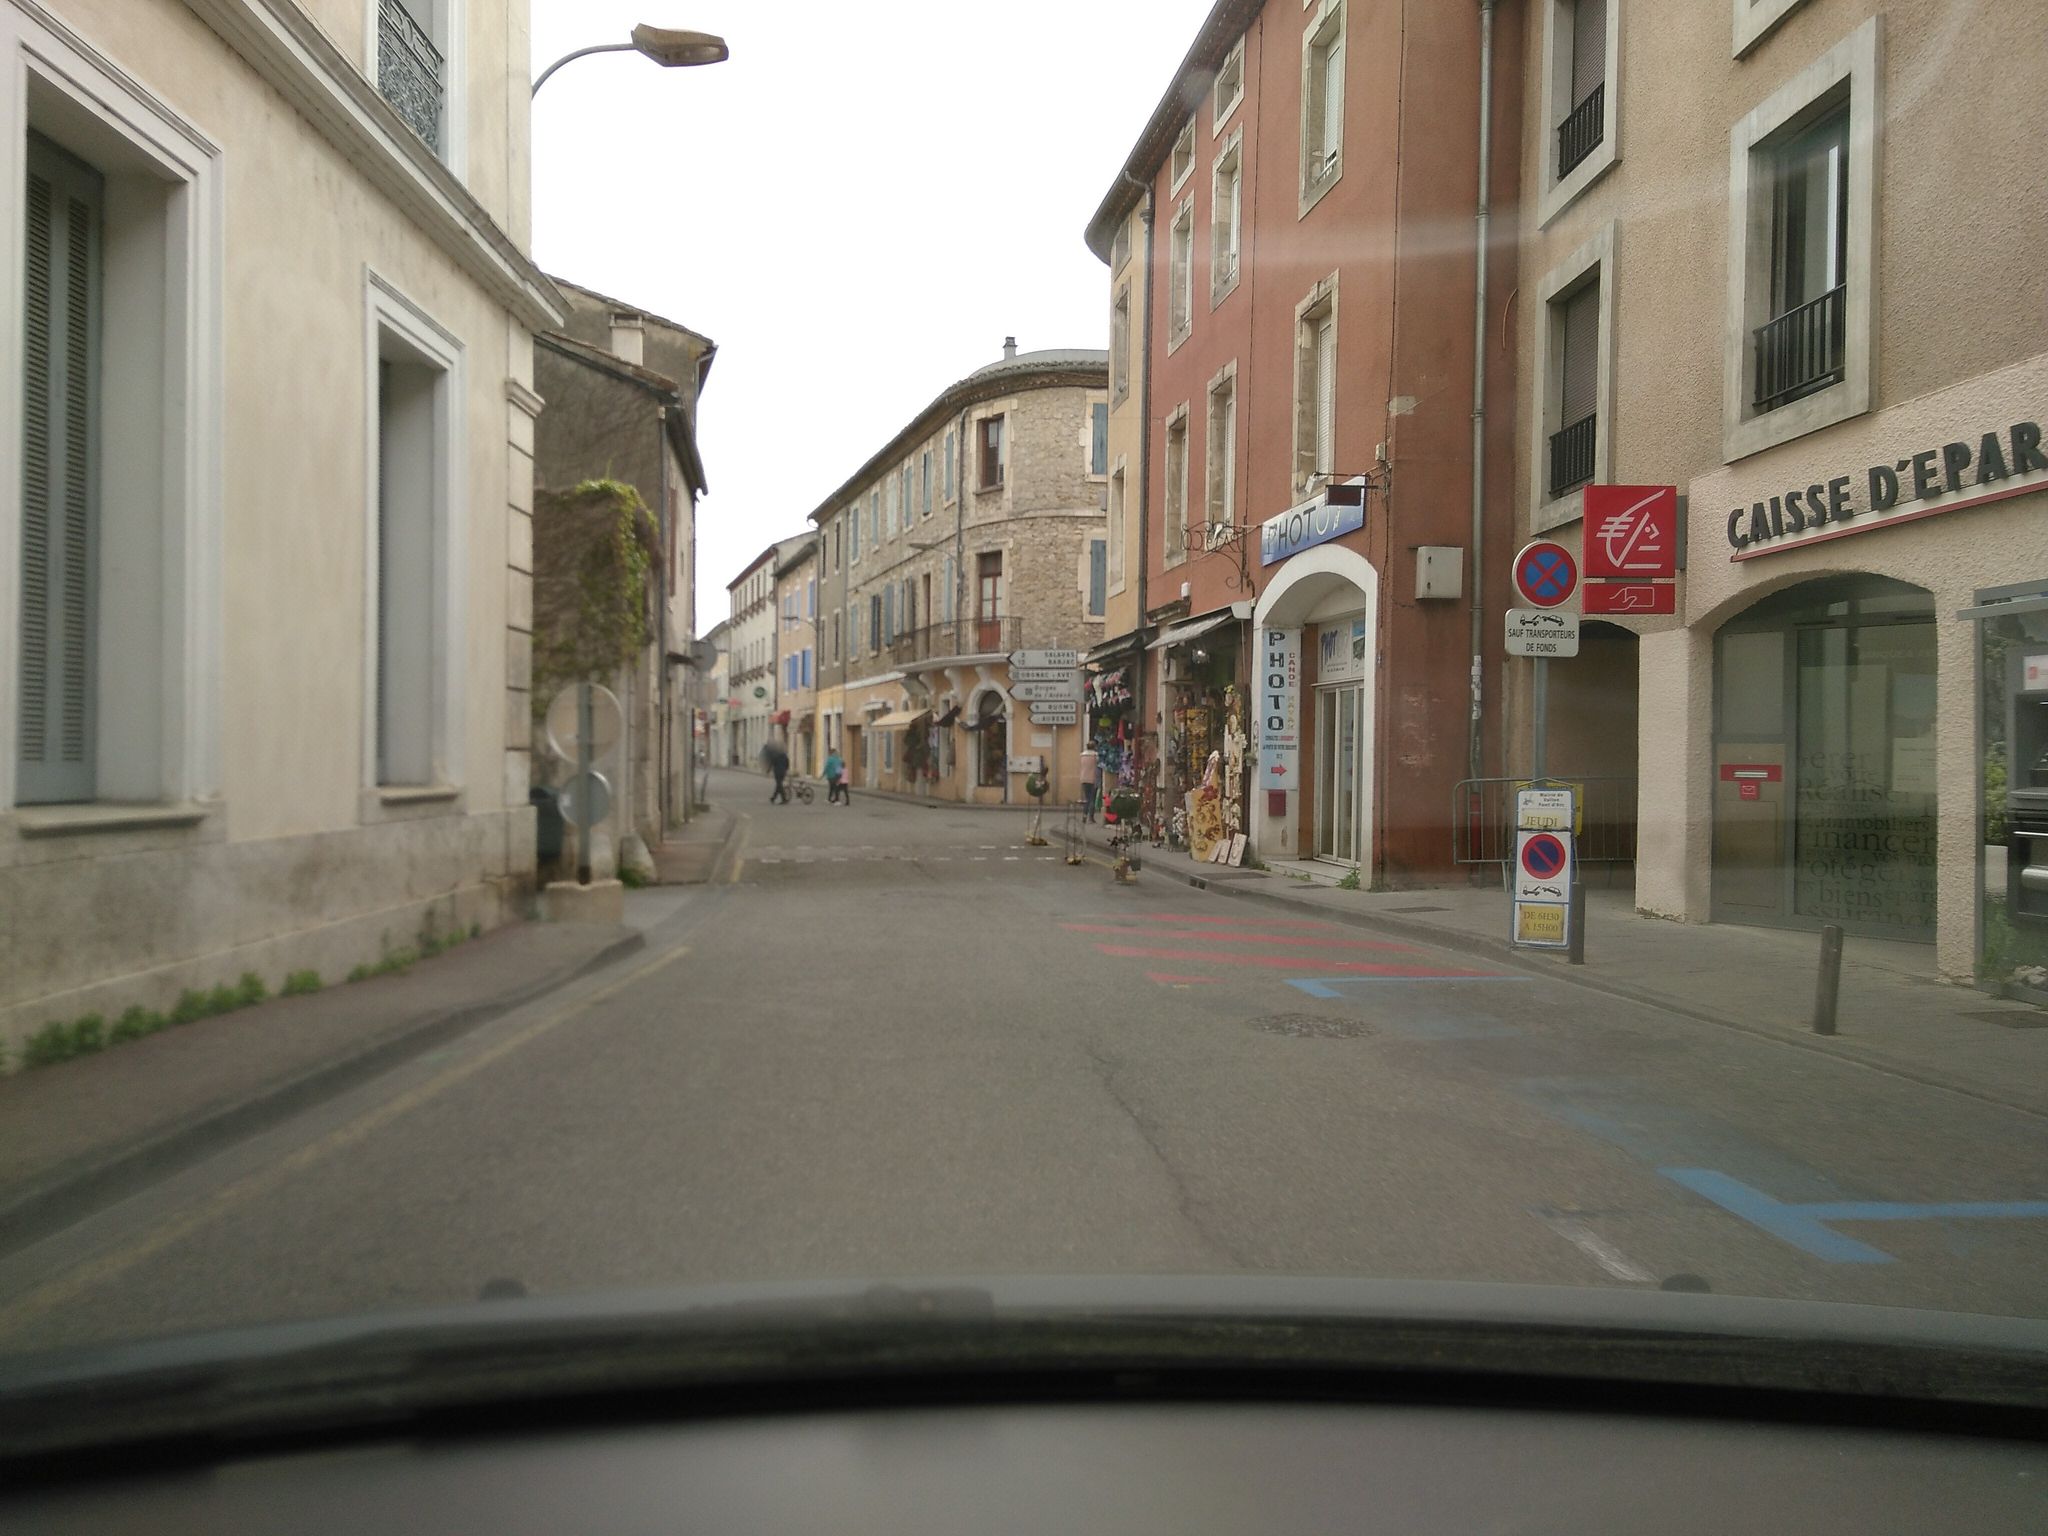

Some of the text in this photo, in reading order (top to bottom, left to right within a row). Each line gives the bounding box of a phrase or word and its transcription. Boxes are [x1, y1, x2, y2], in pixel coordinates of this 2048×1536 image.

[1728, 475, 1854, 548] CAISSE
[1508, 628, 1575, 639] SAUF TRANSPORTEURS
[1526, 643, 1557, 652] DE FONDS
[1267, 631, 1286, 731] PHOTO
[1525, 816, 1559, 828] JEUDI
[1524, 911, 1536, 920] DE
